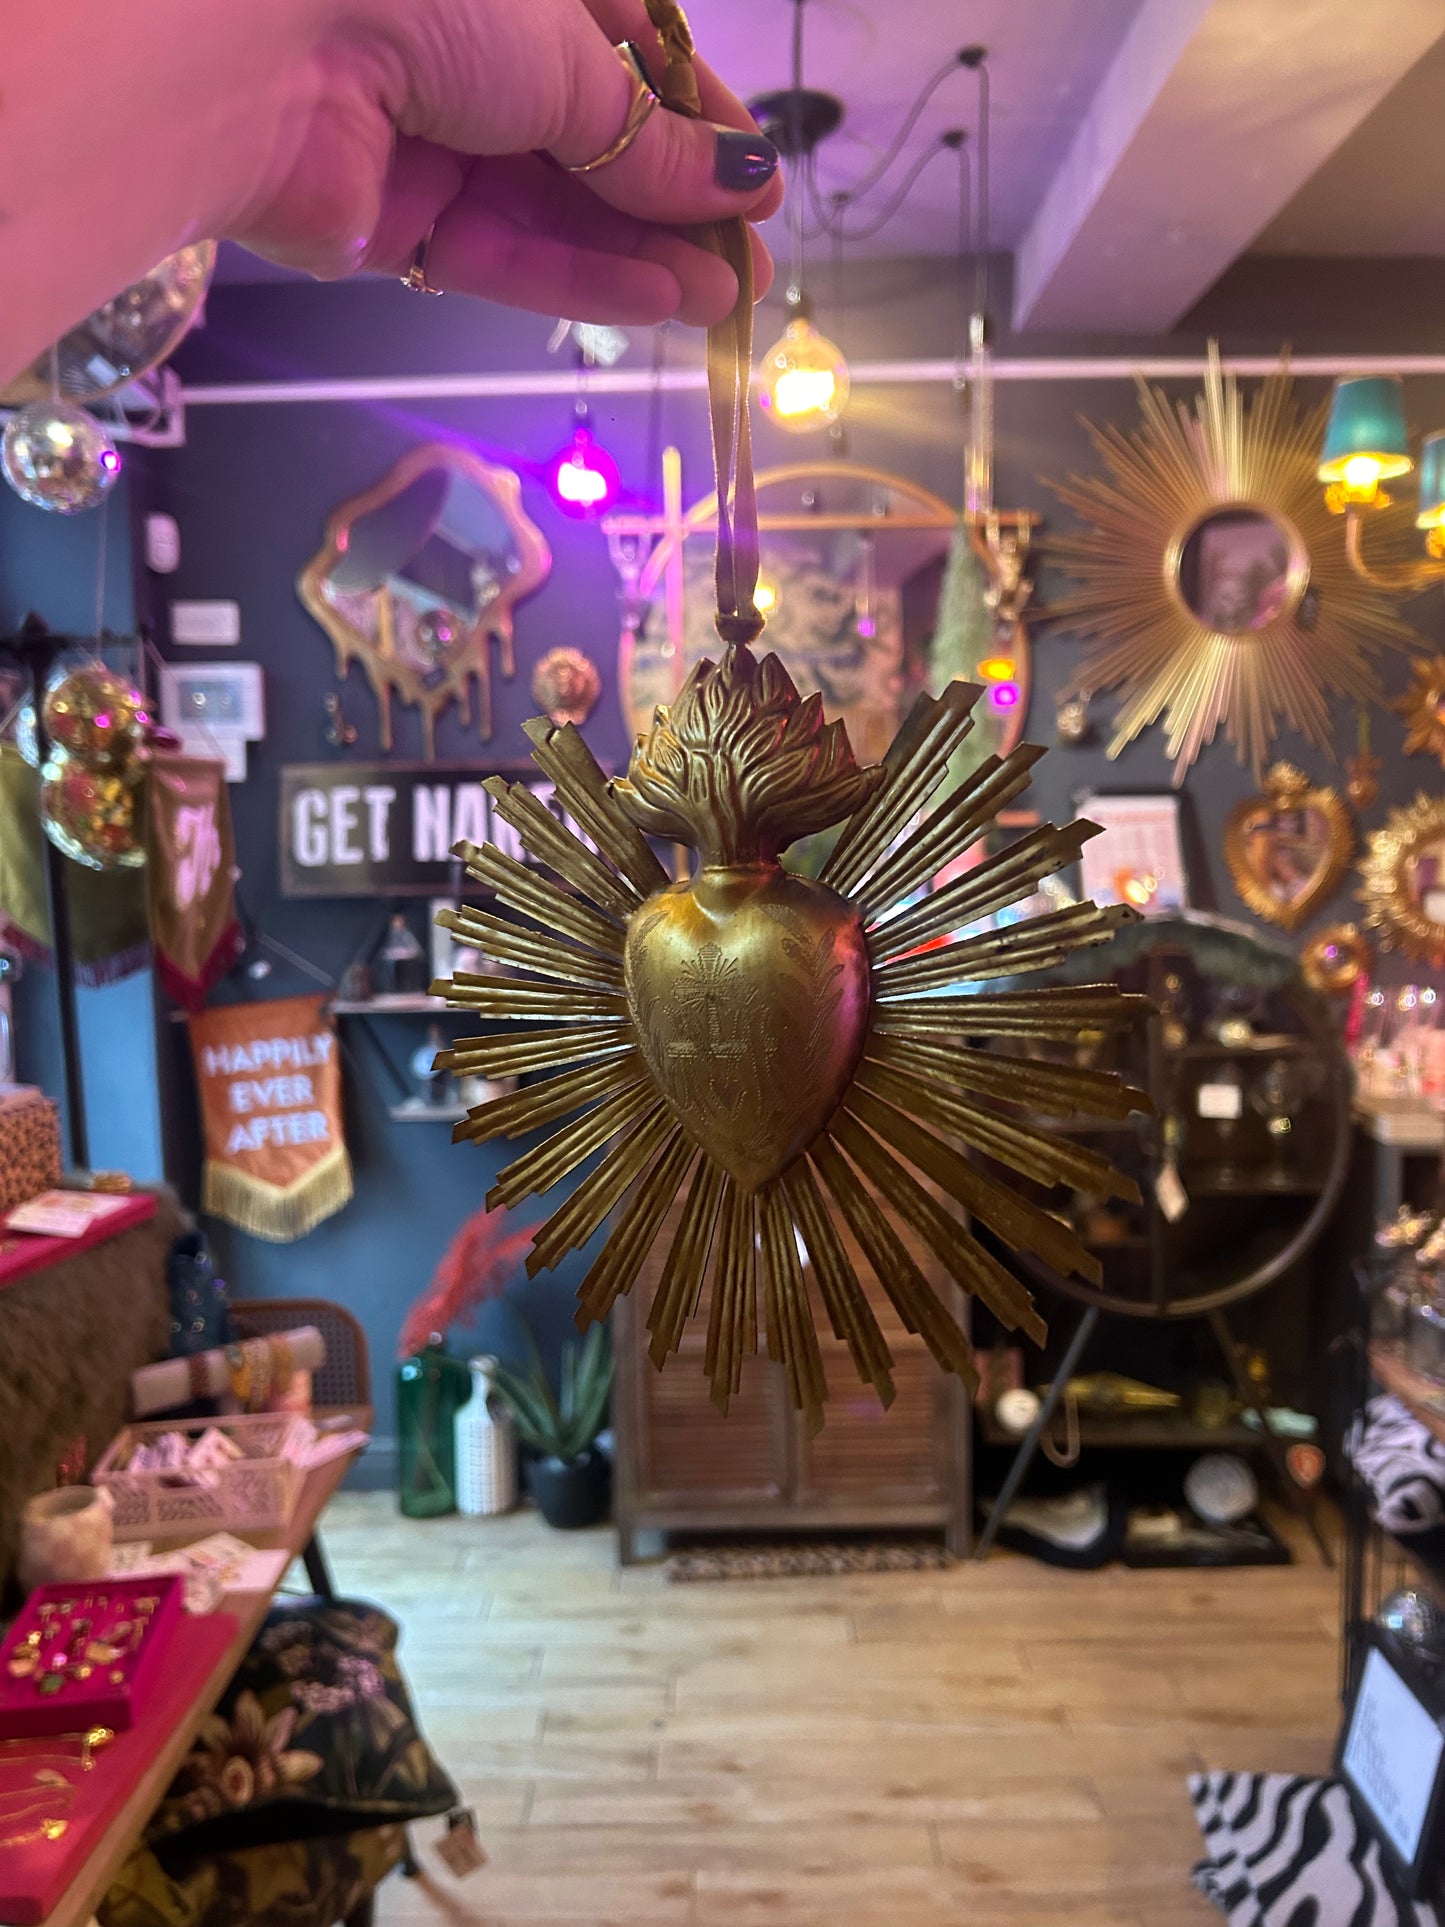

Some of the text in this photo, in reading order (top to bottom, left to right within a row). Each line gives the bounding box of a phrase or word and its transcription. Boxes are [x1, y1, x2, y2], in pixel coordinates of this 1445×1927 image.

[293, 785, 396, 867] GET
[205, 1034, 332, 1076] HAPPILY
[229, 1075, 314, 1114] EVER
[227, 1111, 329, 1155] AFTER
